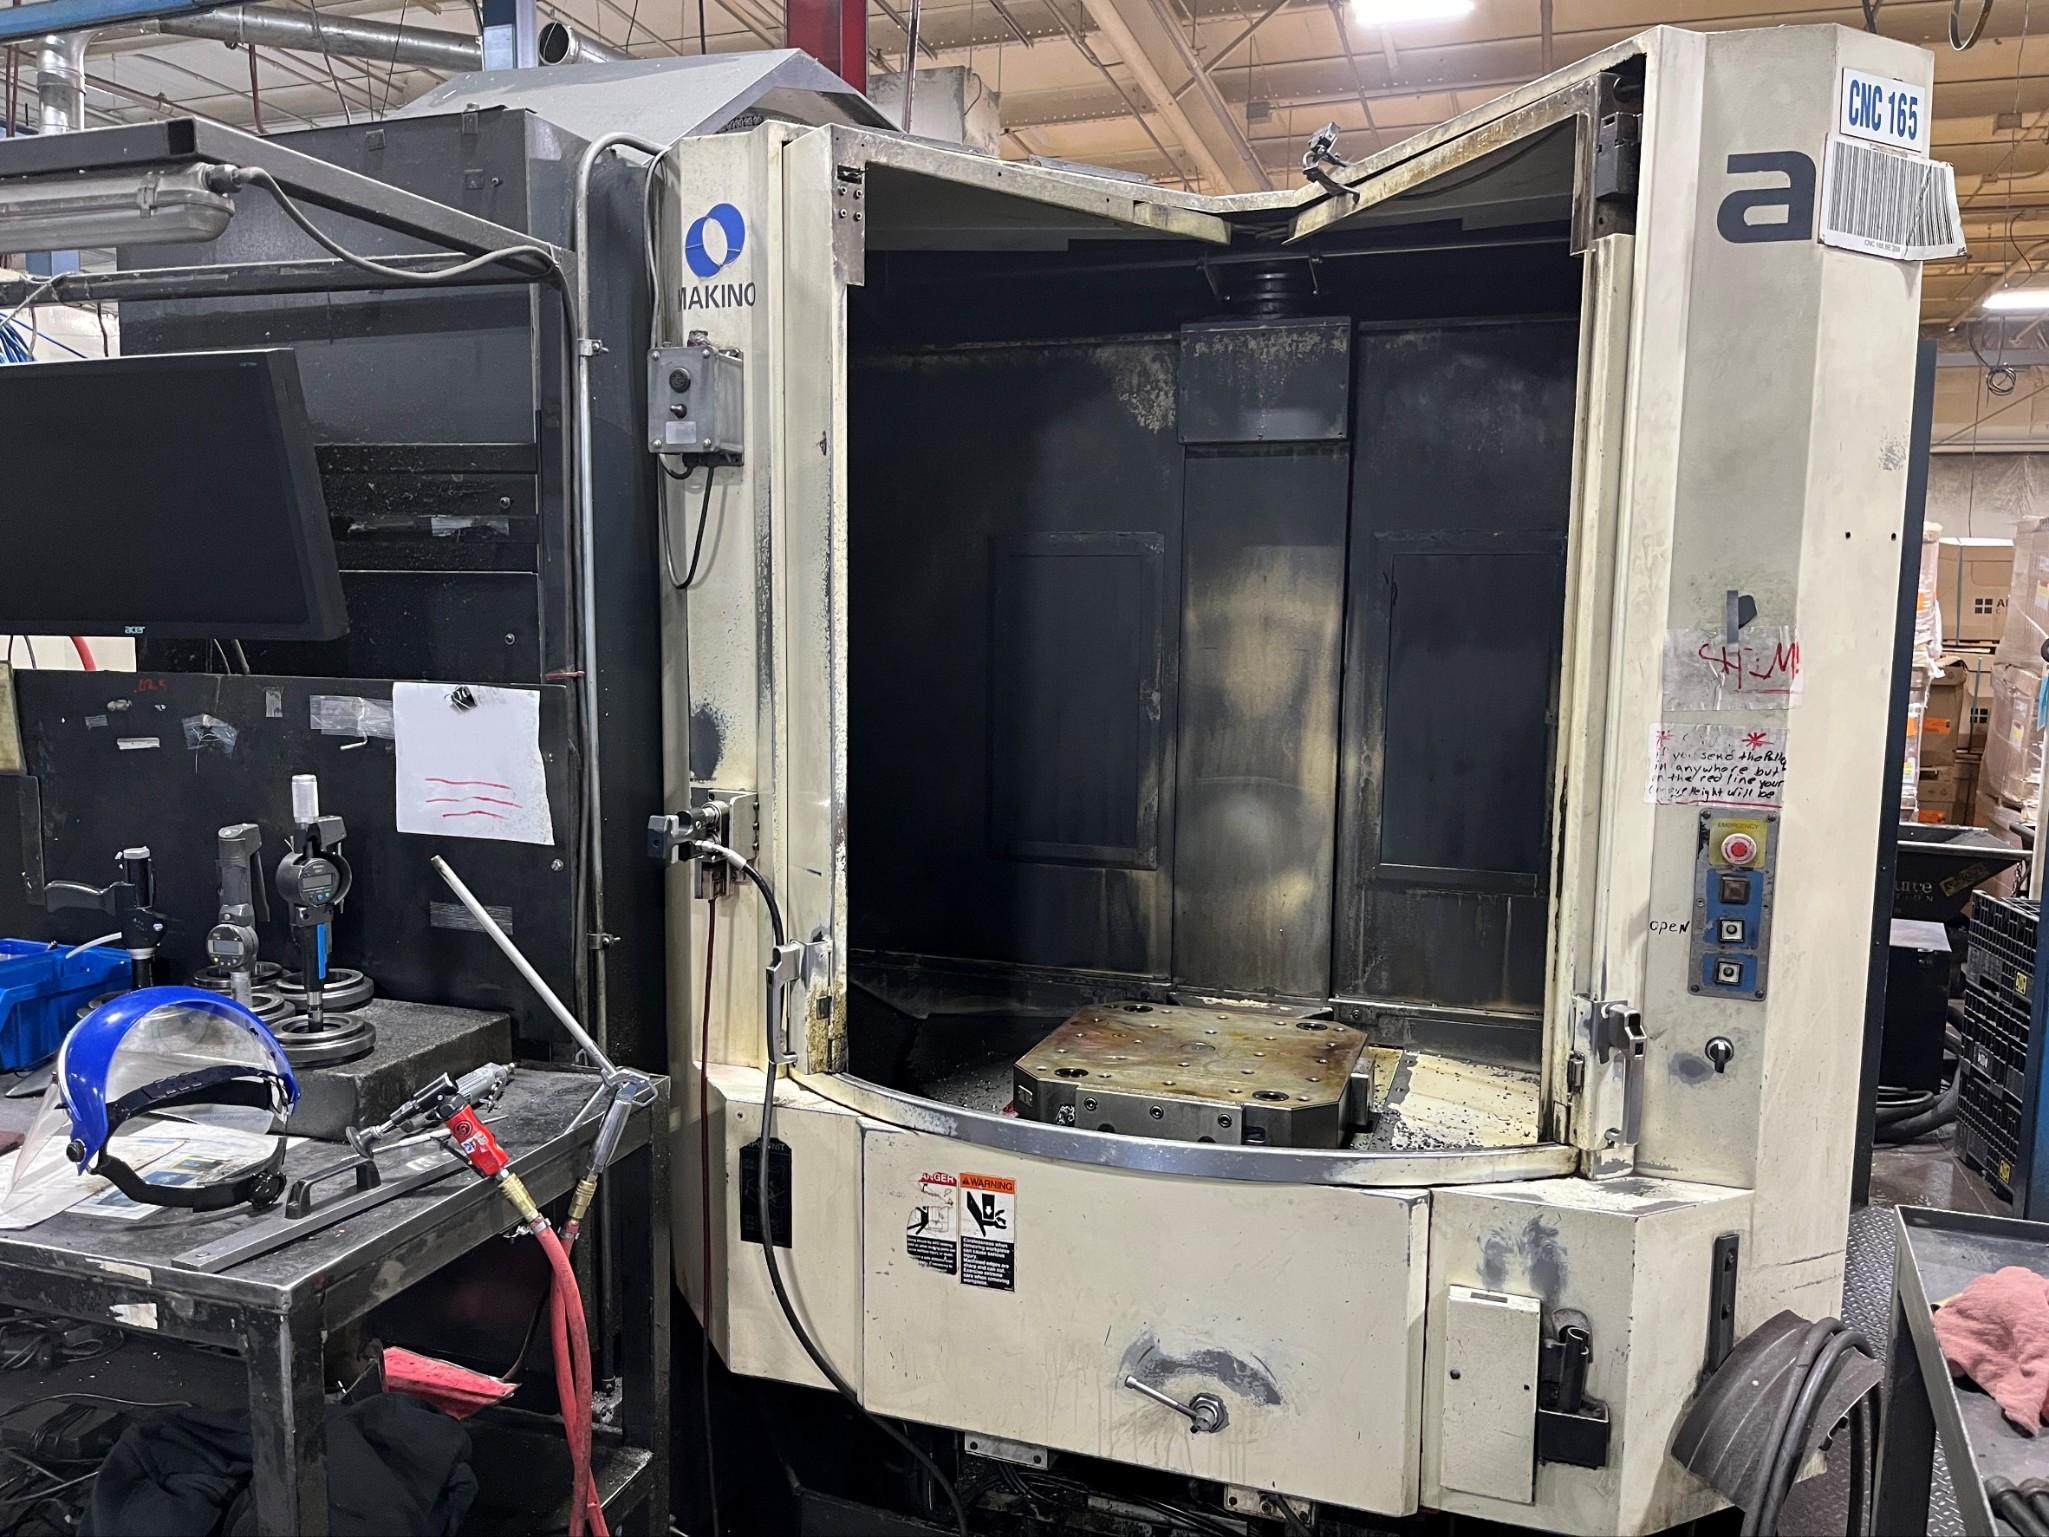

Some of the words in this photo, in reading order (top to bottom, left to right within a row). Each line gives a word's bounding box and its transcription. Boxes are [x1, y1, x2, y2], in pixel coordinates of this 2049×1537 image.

[1849, 79, 1883, 131] CNC
[1888, 91, 1918, 140] 165
[1717, 150, 1817, 244] a
[678, 281, 756, 313] MAKINO
[124, 626, 146, 634] acer
[1676, 763, 1749, 780] anywhere
[1754, 766, 1779, 777] but
[1727, 774, 1756, 785] line
[1760, 780, 1784, 789] your
[1758, 790, 1775, 799] be
[921, 1172, 955, 1184] ANGER
[970, 1178, 1014, 1191] WARNING
